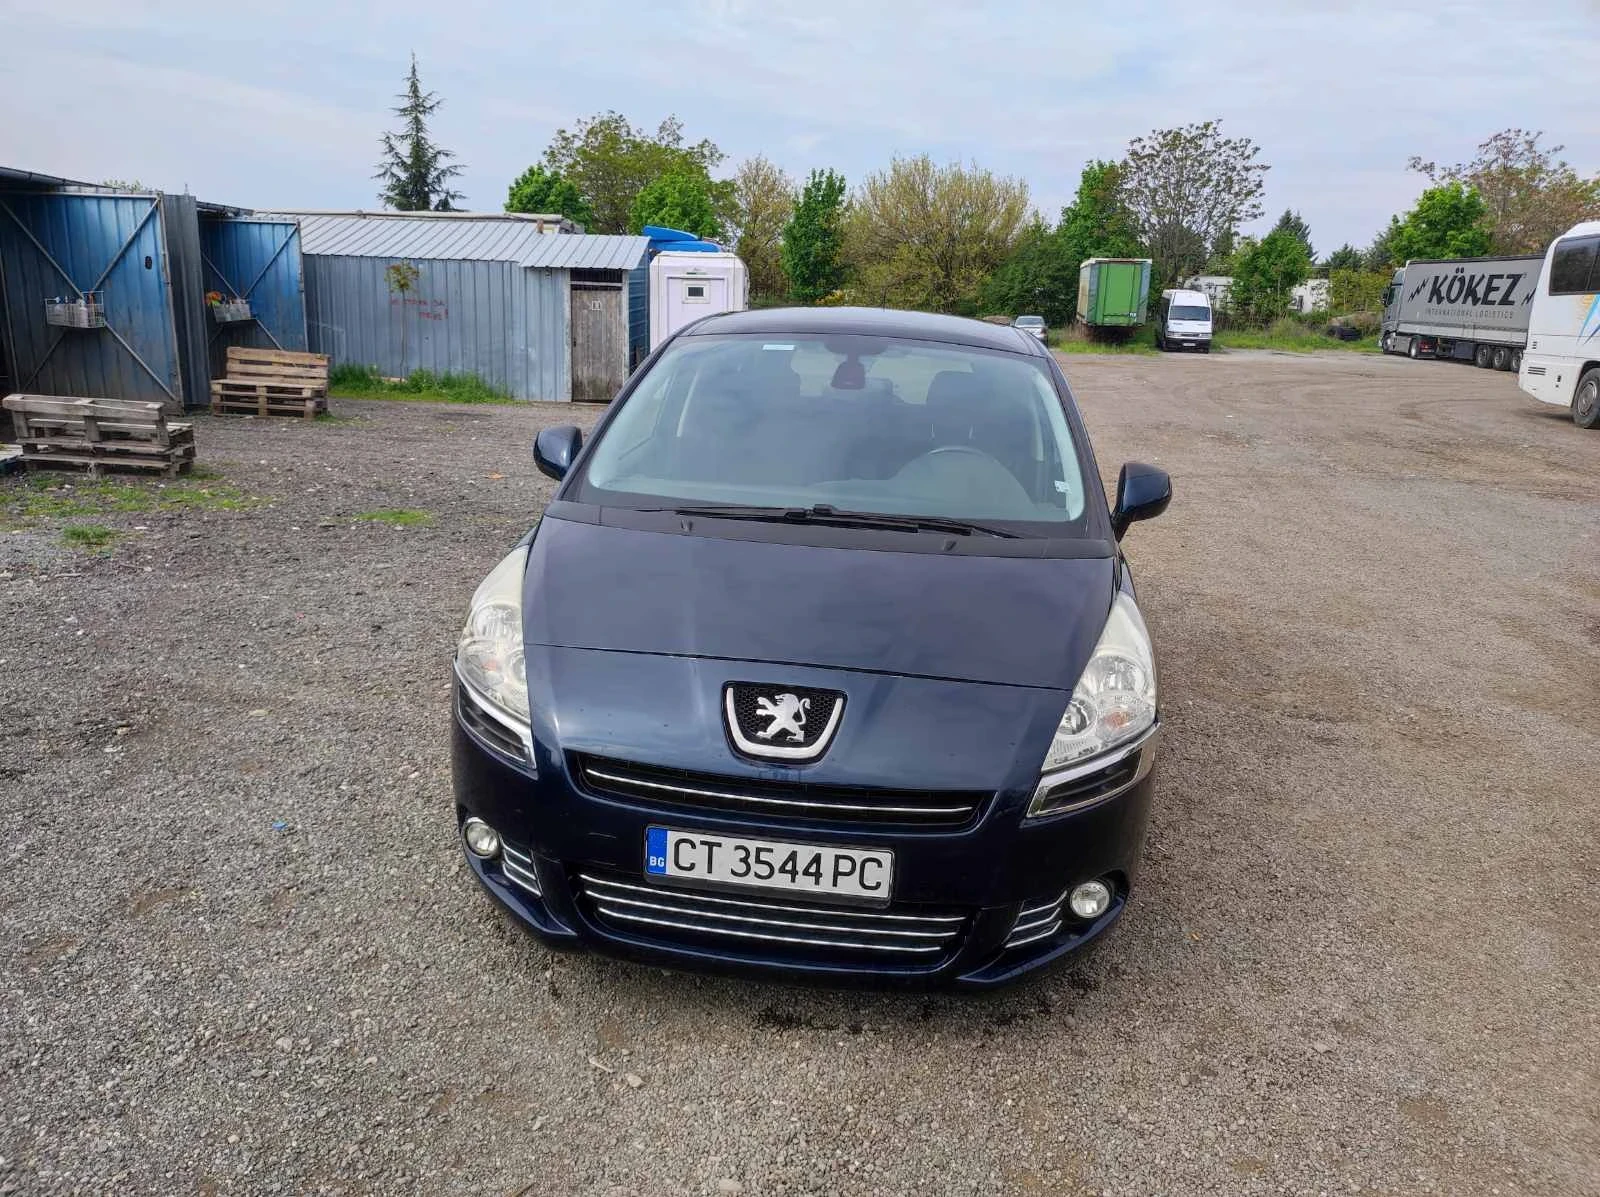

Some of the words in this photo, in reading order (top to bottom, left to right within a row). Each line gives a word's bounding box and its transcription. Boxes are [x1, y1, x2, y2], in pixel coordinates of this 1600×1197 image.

[1427, 266, 1523, 306] KÖKEZ
[649, 855, 665, 868] BG
[673, 838, 722, 874] CT
[730, 844, 823, 886] 3544
[831, 853, 884, 891] PC
